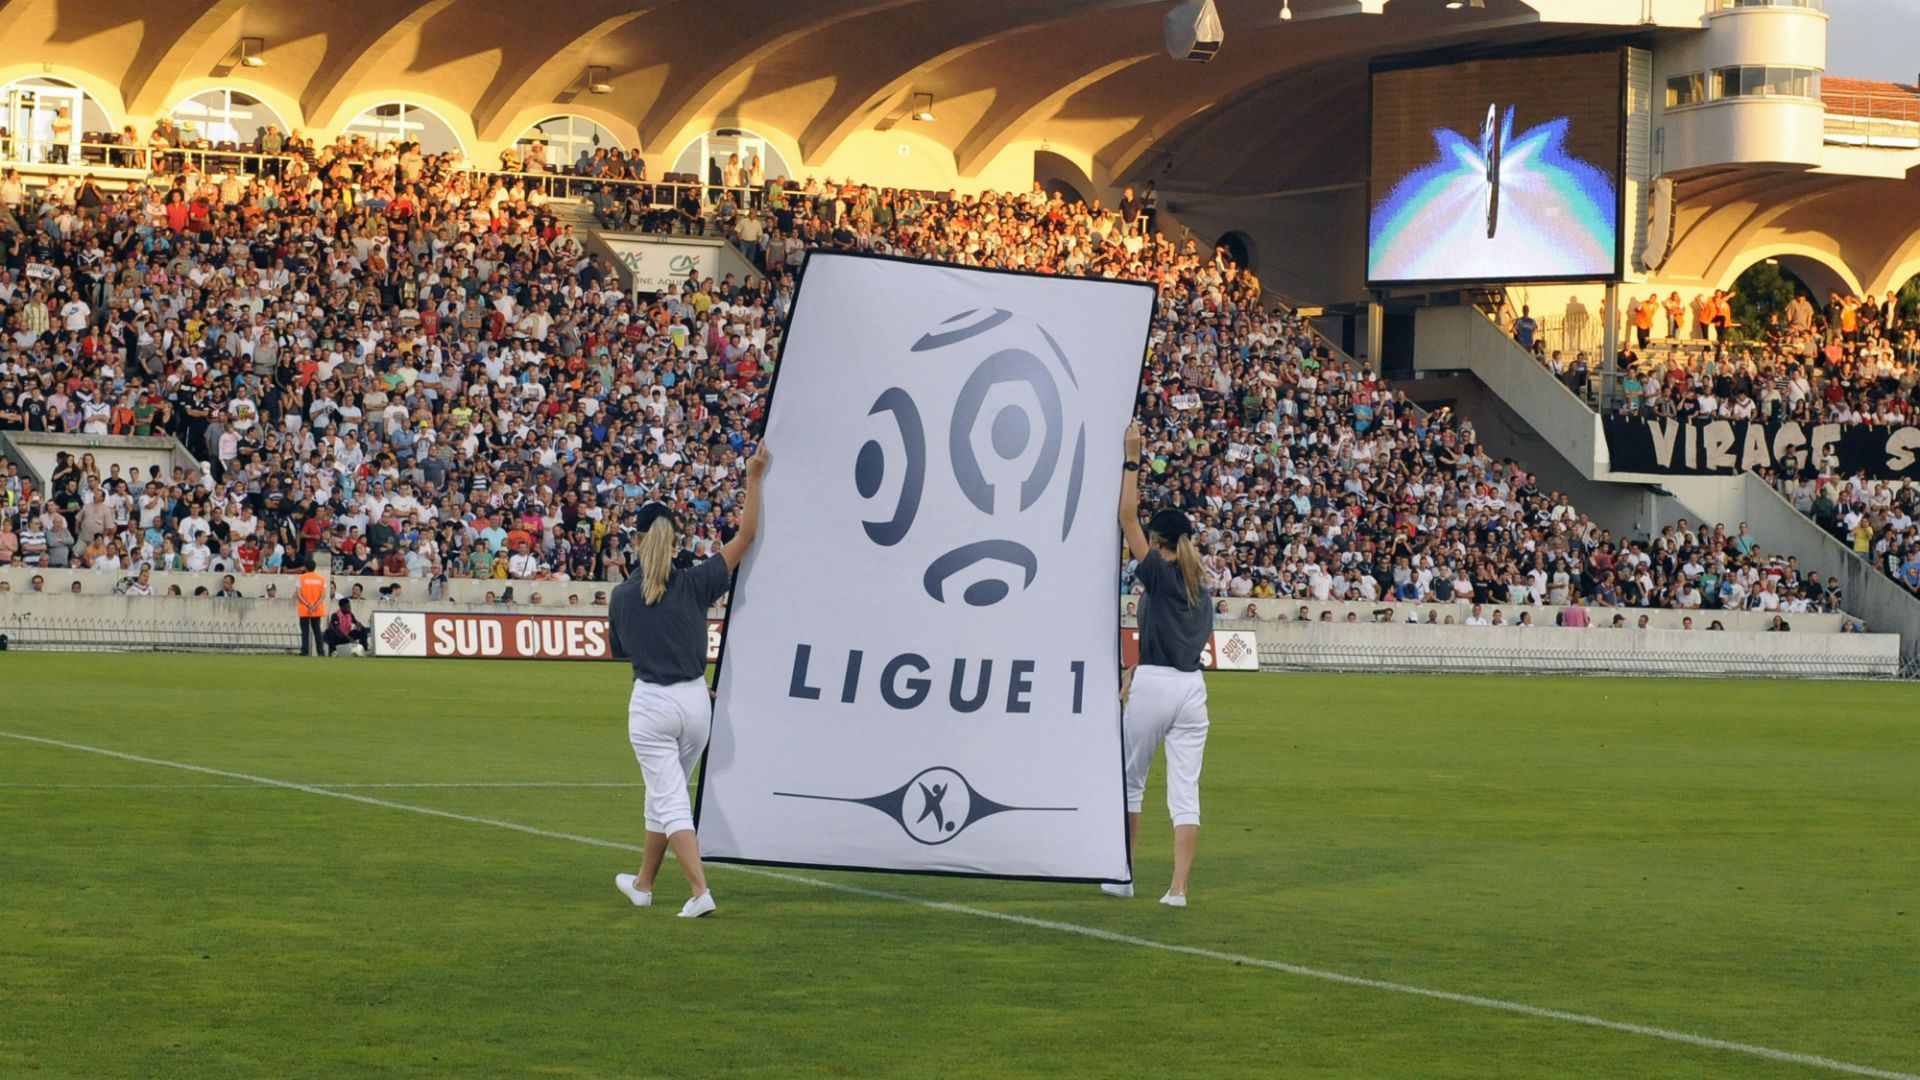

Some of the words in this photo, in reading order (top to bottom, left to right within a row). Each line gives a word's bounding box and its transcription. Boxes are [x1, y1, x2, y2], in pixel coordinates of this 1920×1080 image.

[1647, 417, 1842, 471] VIRAGE
[381, 623, 400, 643] SUD
[433, 619, 502, 656] SUD
[516, 620, 609, 657] OUES
[1222, 639, 1238, 657] SUD
[789, 643, 1035, 713] LIGUE
[1070, 661, 1085, 714] 1
